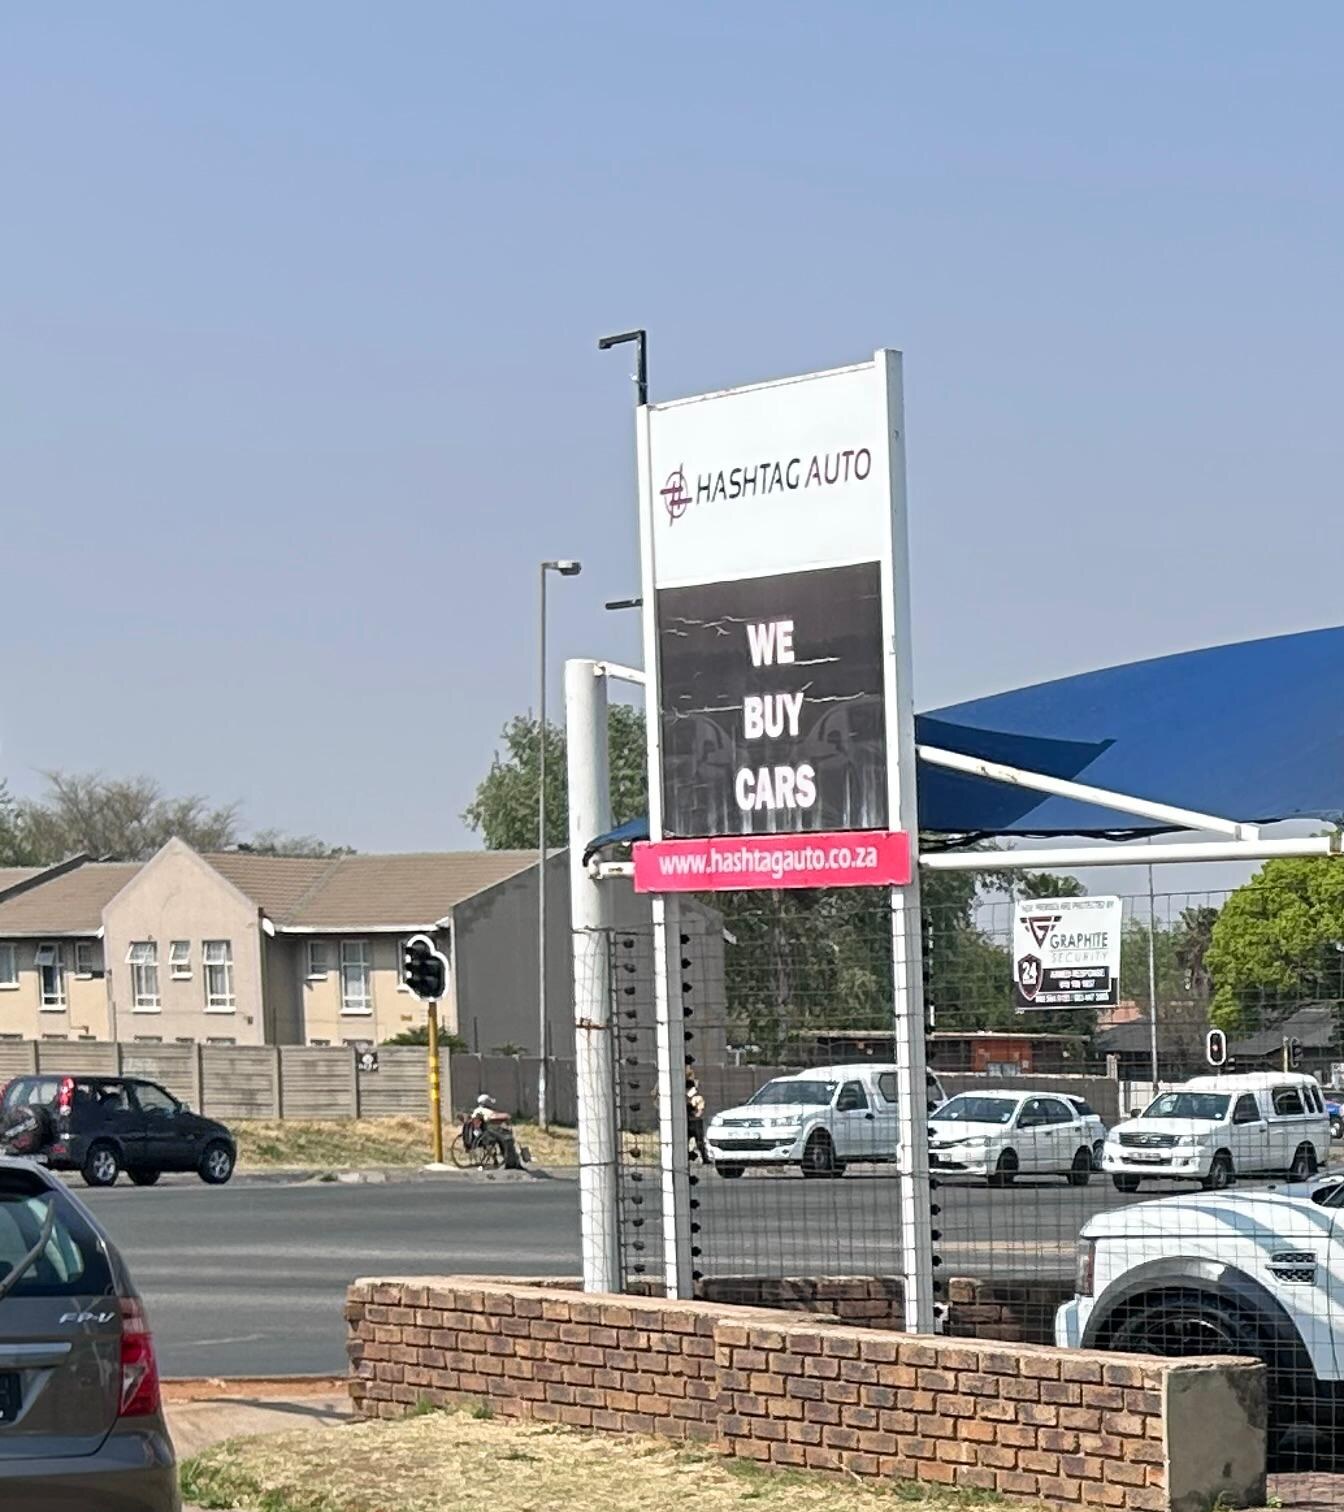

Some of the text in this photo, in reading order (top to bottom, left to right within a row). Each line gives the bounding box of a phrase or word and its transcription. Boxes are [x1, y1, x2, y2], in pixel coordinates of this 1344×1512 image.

[696, 448, 871, 504] HASHTAG AUTO
[746, 620, 795, 666] WE
[743, 692, 804, 740] BUY
[735, 764, 817, 811] CARS
[658, 846, 878, 879] www.hashtagauto.co.za
[1050, 931, 1109, 950] GRAPHITE
[1051, 951, 1108, 964] SECURITY
[1022, 961, 1037, 979] 24
